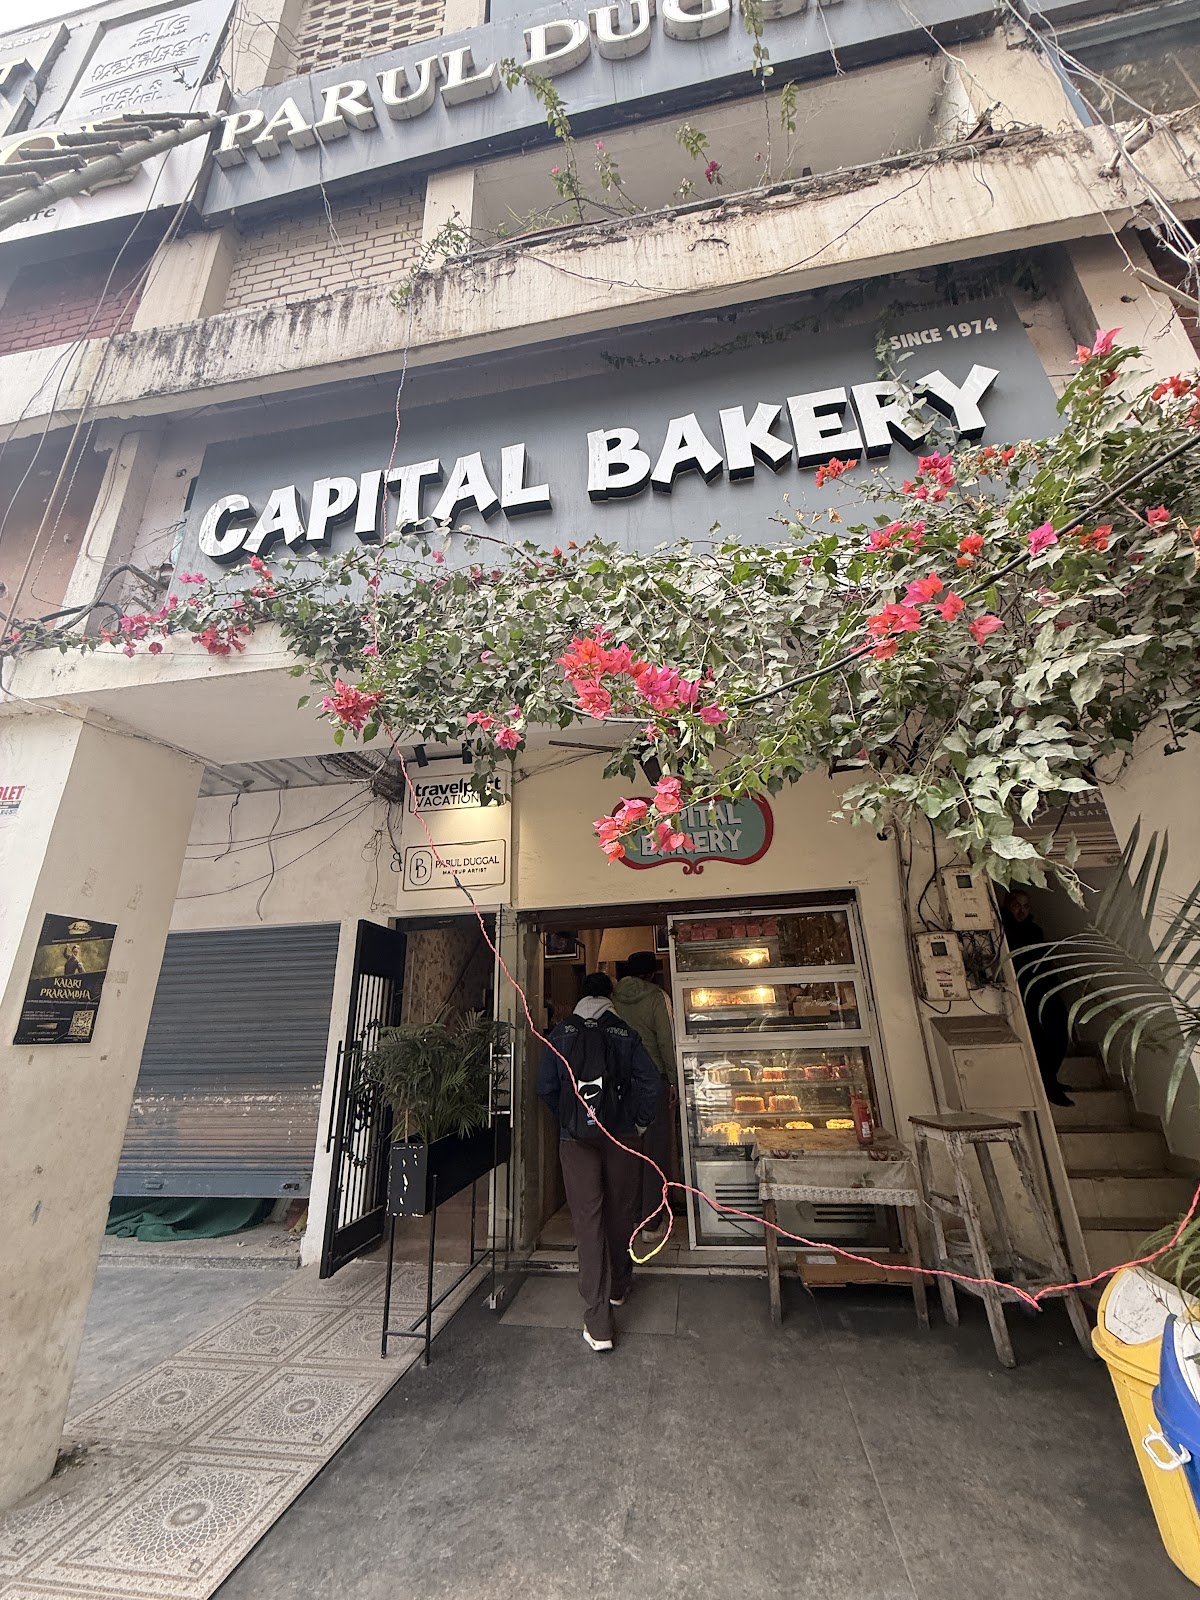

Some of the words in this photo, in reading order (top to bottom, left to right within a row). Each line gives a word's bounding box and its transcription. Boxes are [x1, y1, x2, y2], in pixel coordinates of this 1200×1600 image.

[90, 91, 163, 115] TRAVEL
[101, 84, 143, 105] VISA
[212, 45, 500, 168] PARUL
[889, 327, 942, 350] SINCE
[946, 317, 998, 339] 1974
[197, 441, 552, 565] CAPITAL
[586, 364, 1001, 503] BAKERY
[435, 858, 462, 869] PARUL
[463, 855, 500, 867] DUGGAL
[468, 867, 488, 875] ARTIST
[53, 977, 83, 989] KALARI
[39, 987, 91, 1001] PRARAMBHA
